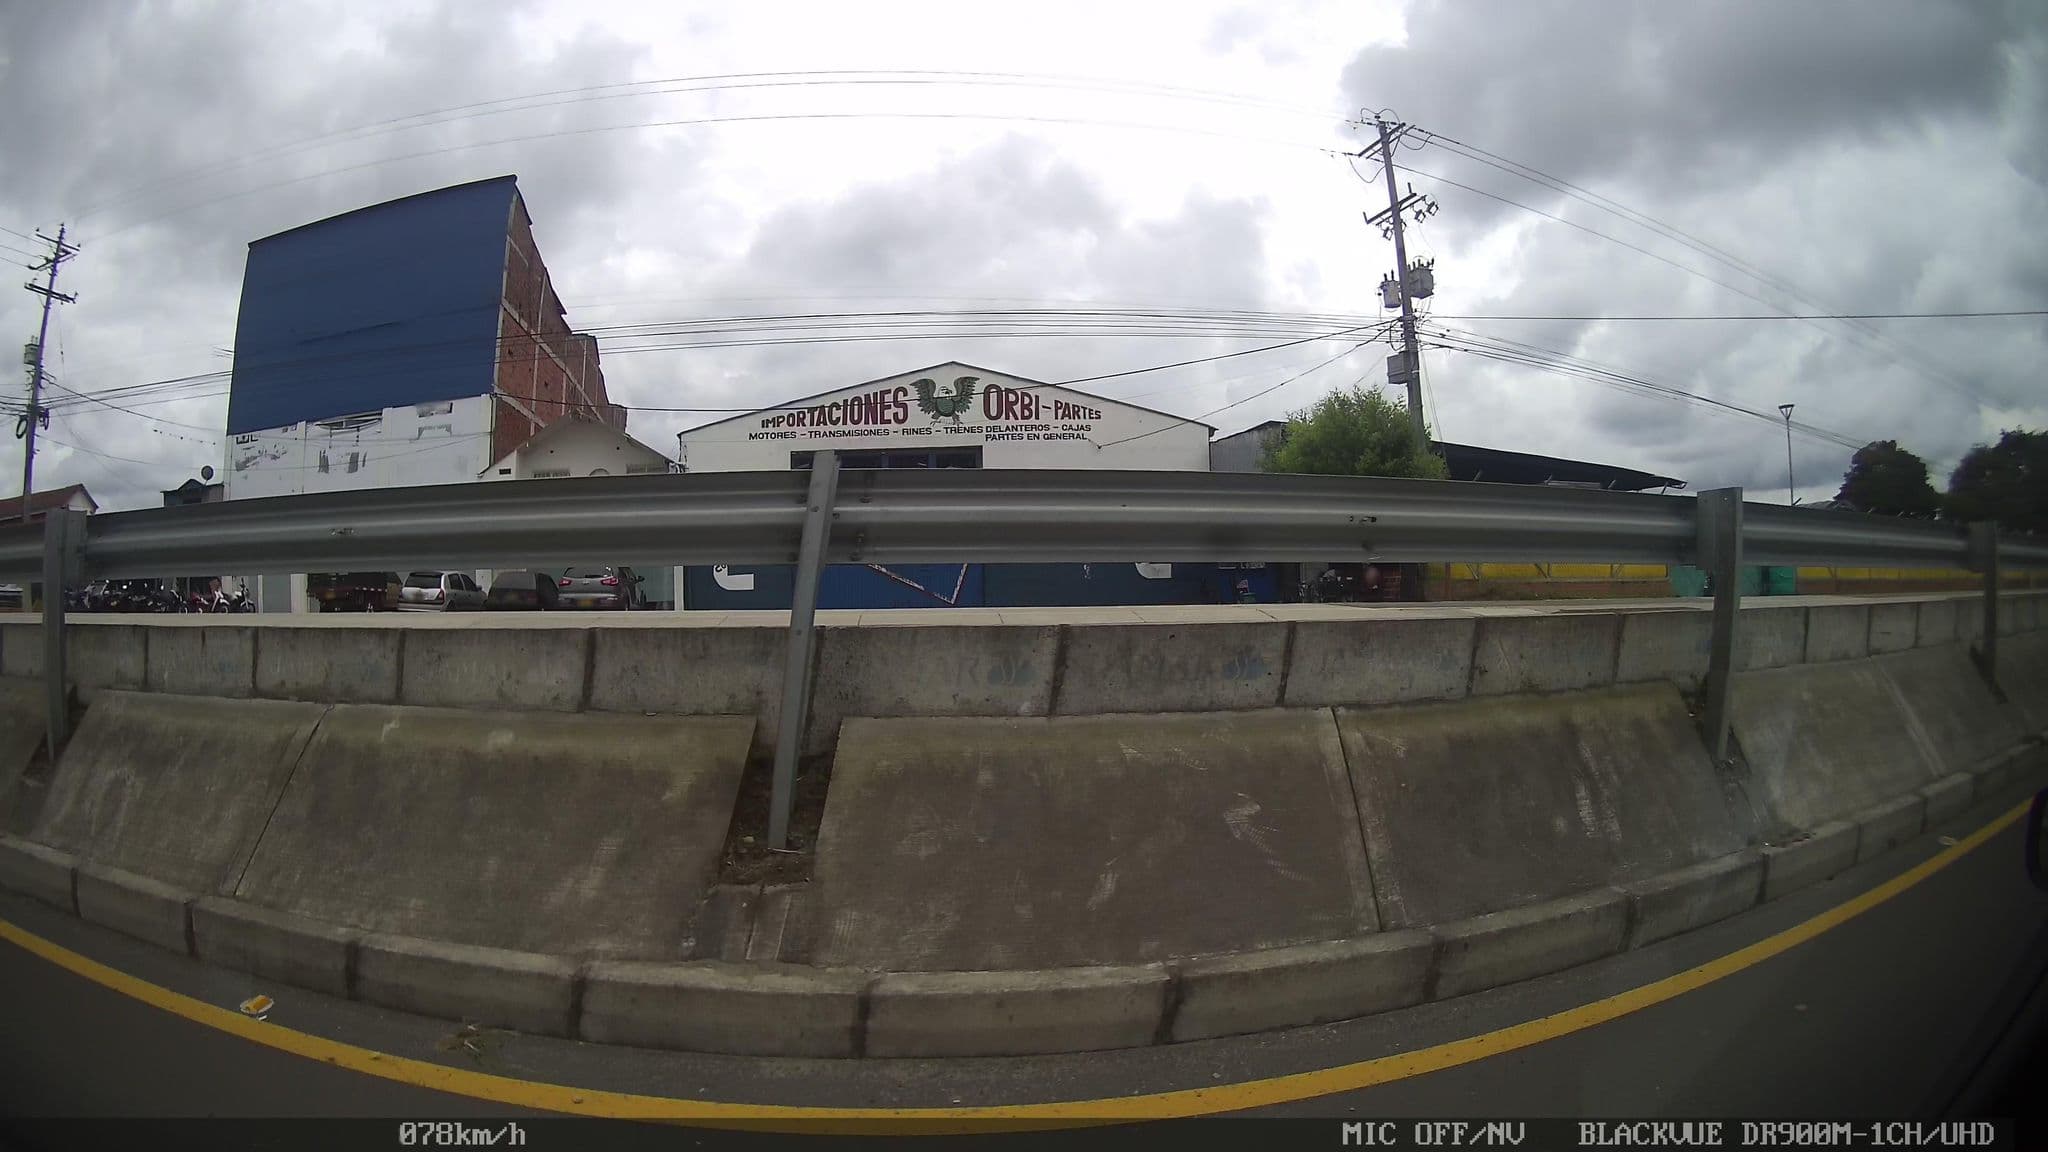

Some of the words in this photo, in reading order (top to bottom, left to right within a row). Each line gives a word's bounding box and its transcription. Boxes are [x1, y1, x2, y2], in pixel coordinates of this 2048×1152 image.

[761, 386, 909, 429] IMPORTACIONES
[749, 431, 797, 441] MOTORES
[808, 428, 890, 439] TRANSMISIONES
[902, 427, 932, 436] RINES
[943, 426, 983, 434] TRENES
[985, 424, 1051, 433] DELANTEROS
[1061, 424, 1091, 432] CAJAS
[985, 433, 1024, 441] PARTES
[1027, 433, 1040, 441] EN
